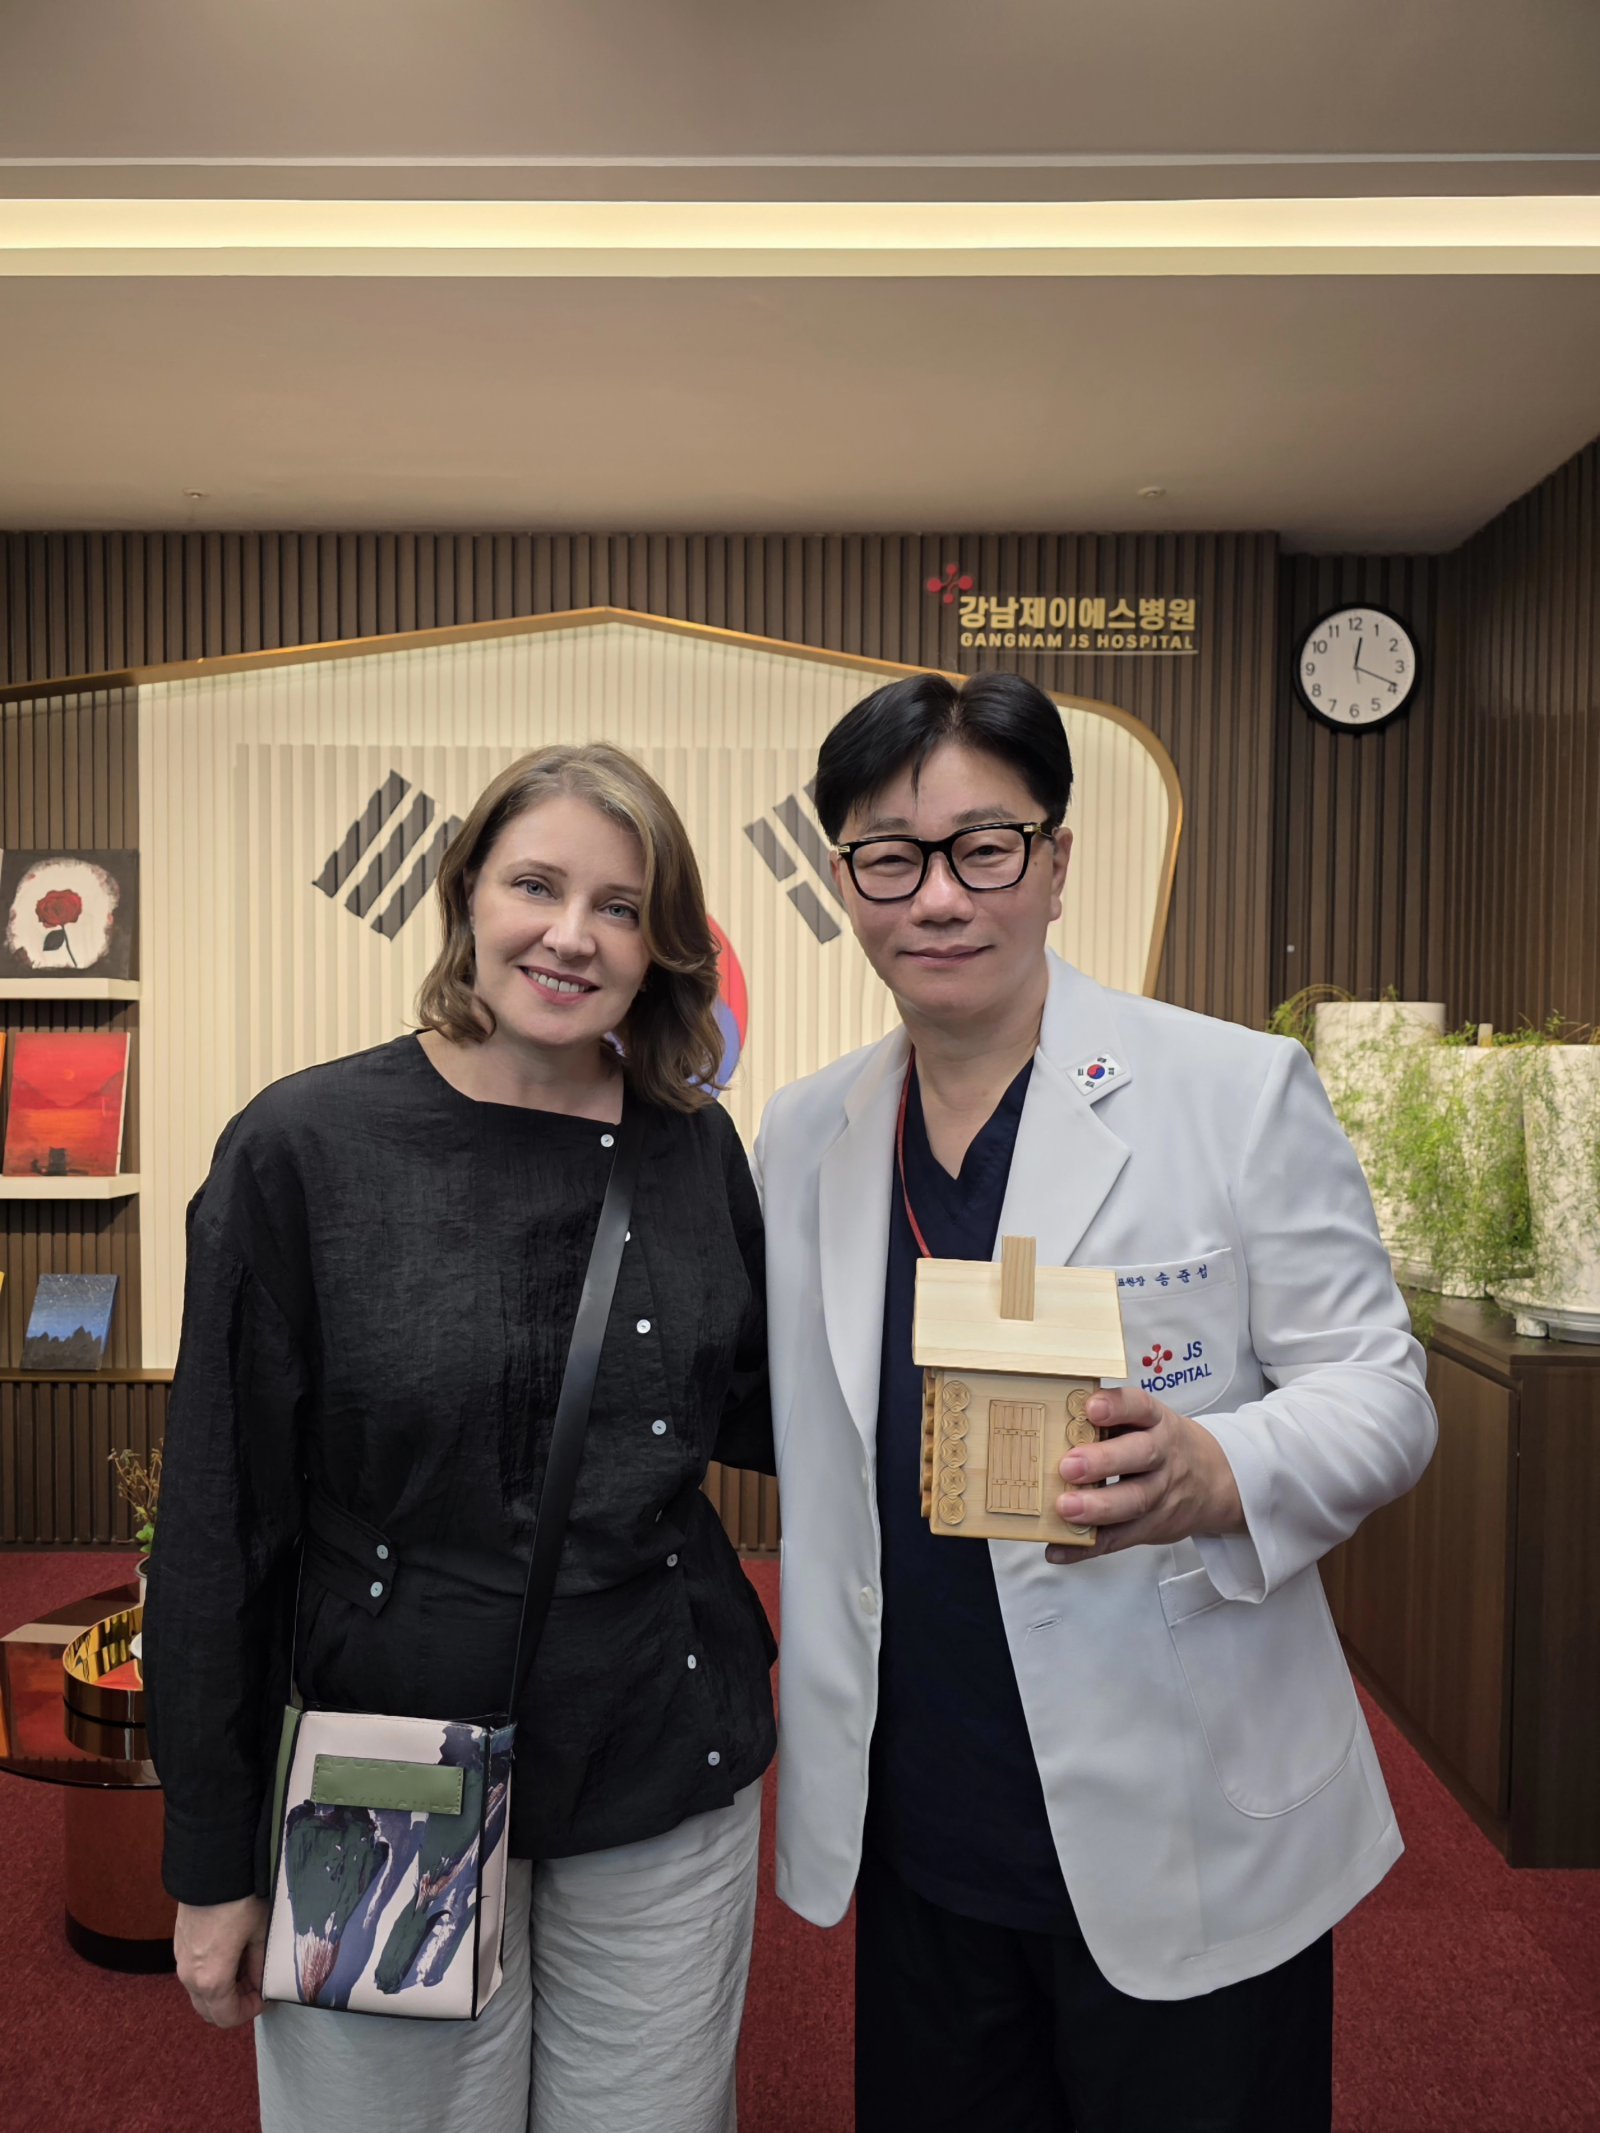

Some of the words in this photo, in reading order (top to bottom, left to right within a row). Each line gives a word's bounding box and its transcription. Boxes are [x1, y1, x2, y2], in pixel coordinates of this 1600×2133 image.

[959, 596, 1196, 631] 강남제이에스병원
[1348, 617, 1363, 631] 12
[1374, 623, 1379, 637] 1
[1328, 625, 1339, 638] 11
[960, 632, 1062, 648] GANGNAM
[1069, 633, 1090, 649] JS
[1097, 634, 1193, 649] HOSPITAL
[1312, 640, 1328, 654] 10
[1389, 638, 1398, 652] 2
[1305, 662, 1315, 676] 9
[1395, 660, 1405, 673] 3
[1311, 683, 1322, 697] 8
[1329, 699, 1337, 712] 7
[1349, 704, 1359, 718] 6
[1371, 698, 1381, 711] 5
[1182, 1340, 1203, 1361] JS
[1140, 1363, 1212, 1392] HOSPITAL
